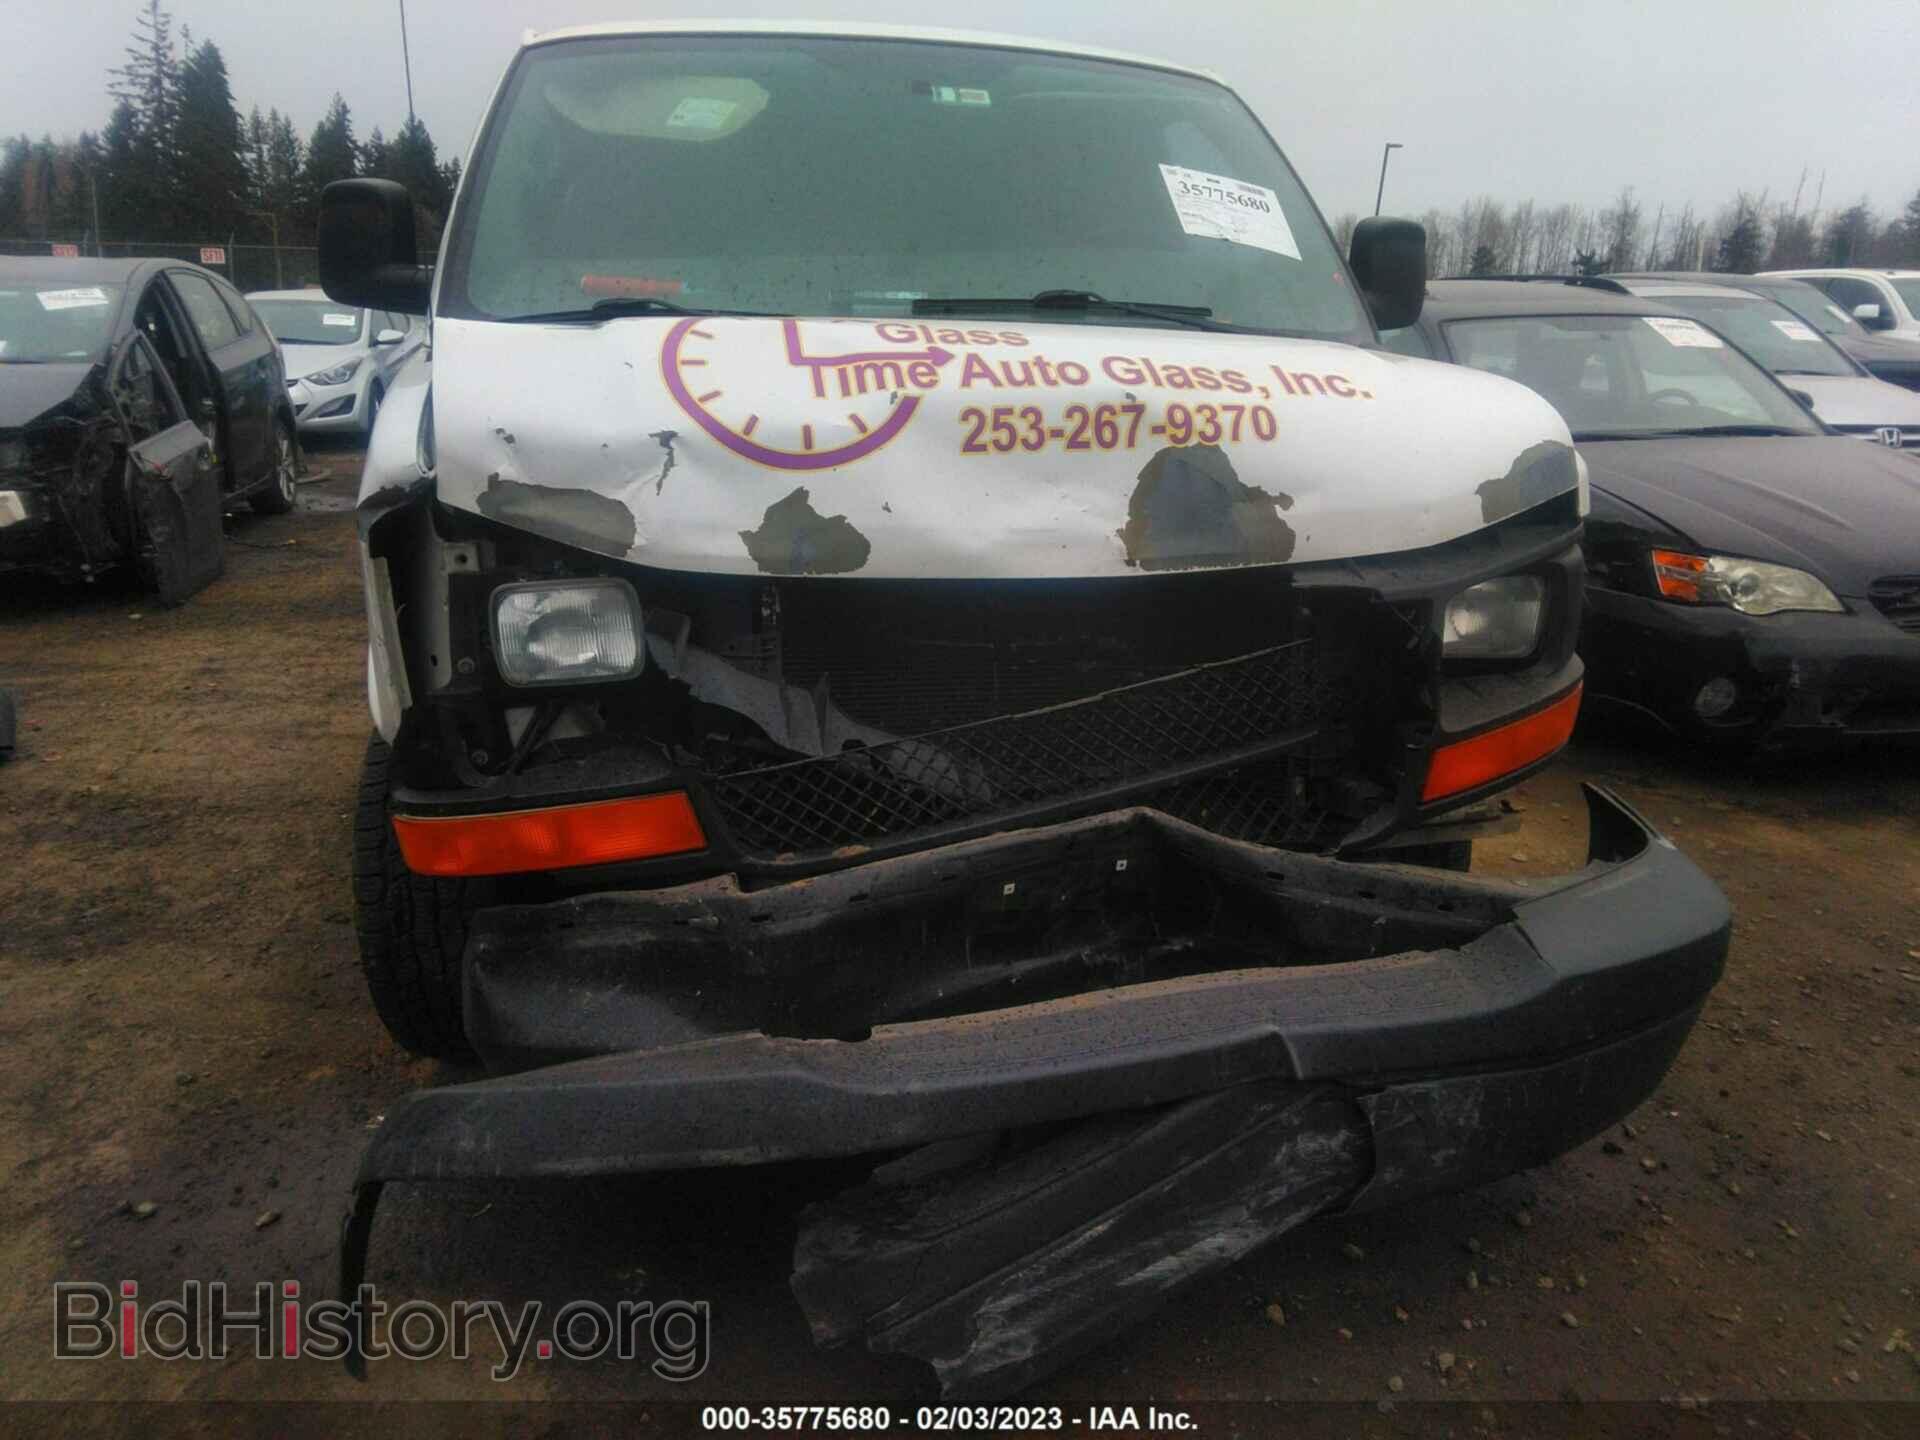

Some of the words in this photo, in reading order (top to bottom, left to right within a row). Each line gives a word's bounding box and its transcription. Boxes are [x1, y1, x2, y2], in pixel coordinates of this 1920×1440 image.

[1177, 180, 1271, 214] 35775680
[875, 321, 1030, 347] Glass
[808, 354, 939, 400] Time
[960, 352, 1090, 388] Auto
[1103, 355, 1269, 400] Glass,
[1273, 364, 1373, 400] Inc.
[959, 403, 1278, 454] 253-267-9370
